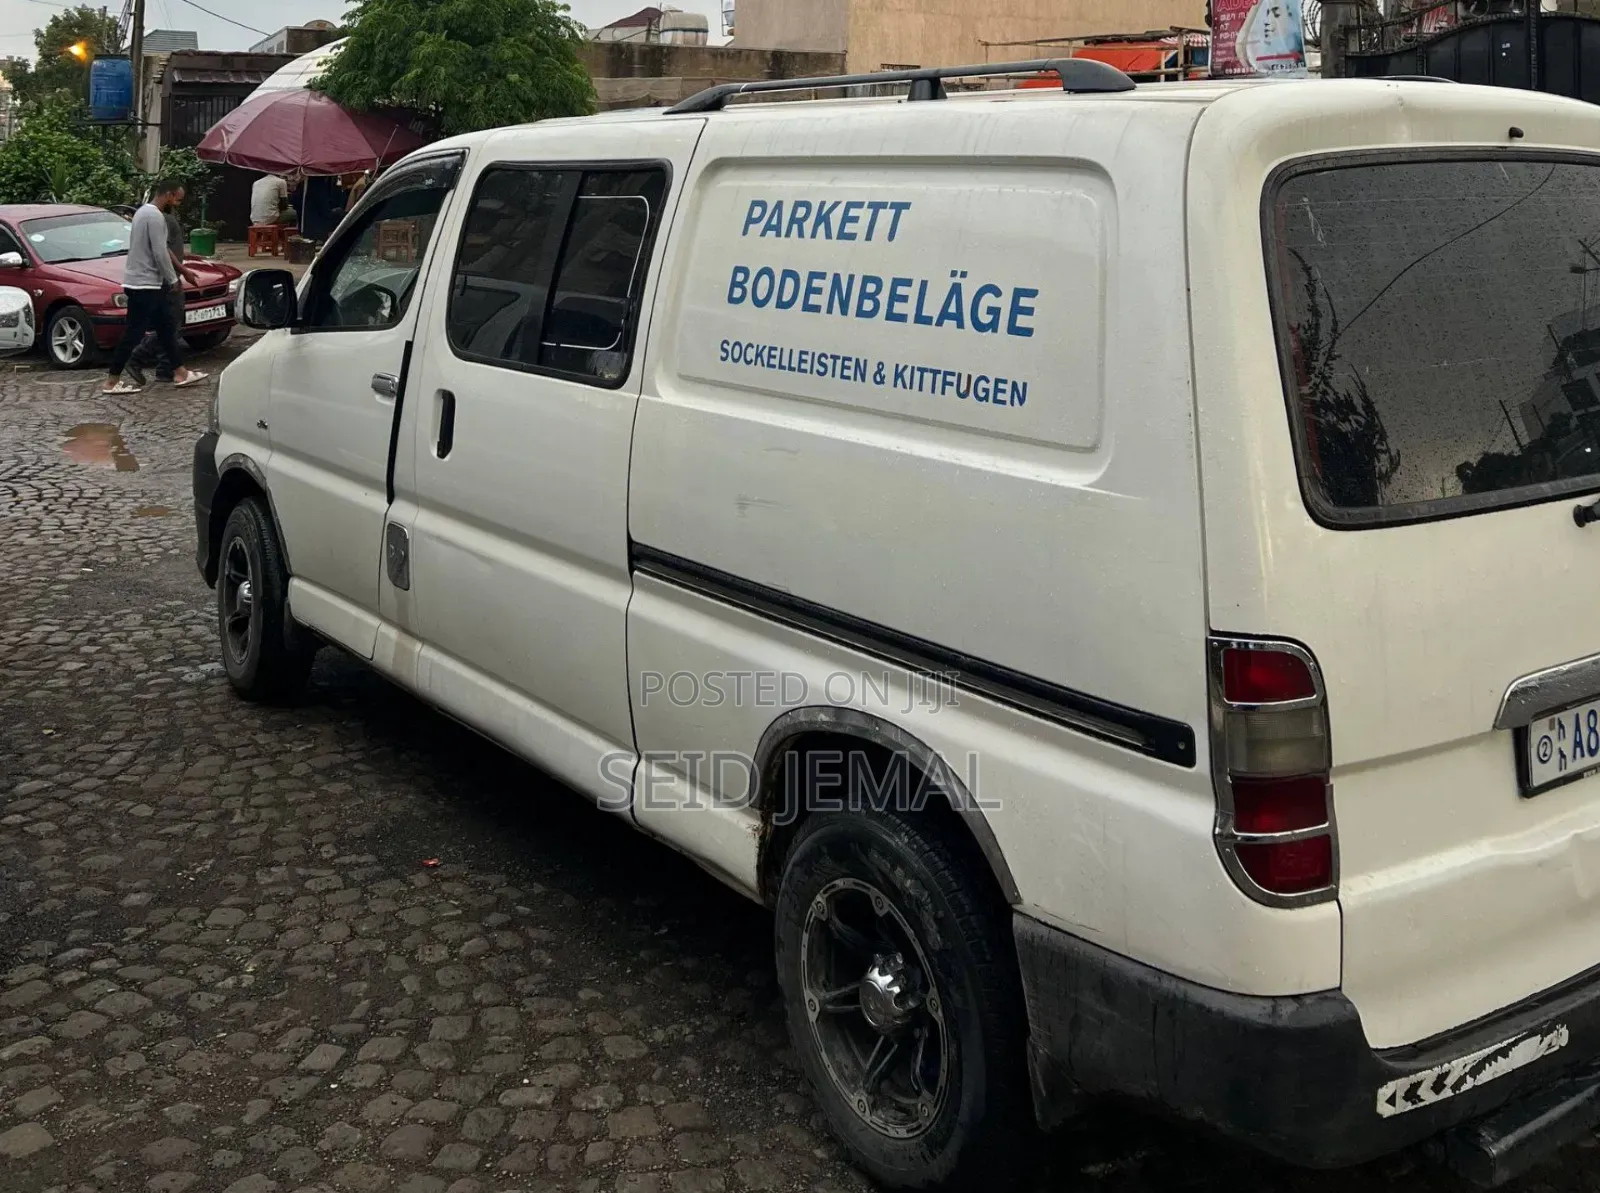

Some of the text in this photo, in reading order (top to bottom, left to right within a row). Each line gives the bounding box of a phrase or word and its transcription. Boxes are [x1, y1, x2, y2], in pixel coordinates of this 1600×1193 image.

[743, 200, 911, 241] PARKETT
[728, 266, 1038, 337] BODENBELÄGE
[720, 340, 1027, 406] SOCKELLEISTEN & KITTFUGEN
[1572, 708, 1600, 763] A8
